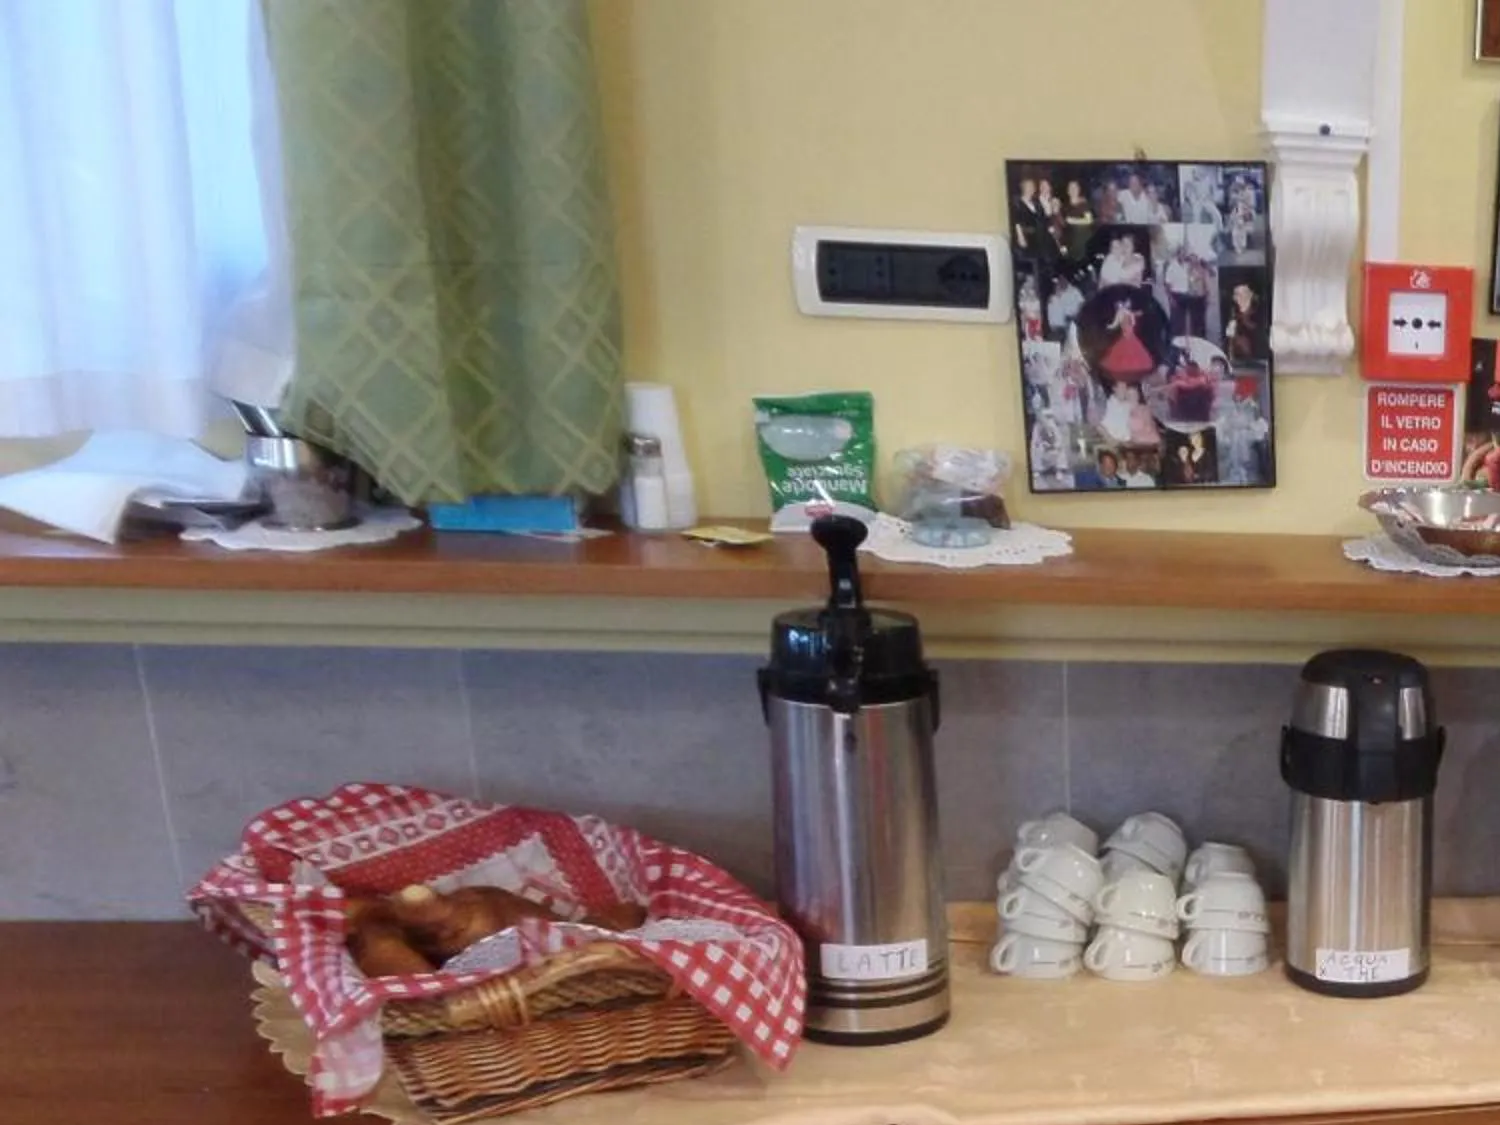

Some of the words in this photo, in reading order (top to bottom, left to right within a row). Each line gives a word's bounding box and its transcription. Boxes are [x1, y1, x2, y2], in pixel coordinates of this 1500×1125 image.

[1377, 392, 1446, 408] ROMPERE
[1381, 414, 1393, 429] IL
[1396, 415, 1441, 430] VETRO
[1383, 437, 1397, 451] IN
[1400, 438, 1439, 453] CASO
[786, 463, 865, 478] Sguciate
[1371, 459, 1448, 475] D'INCENDIO
[837, 947, 920, 973] LATTE
